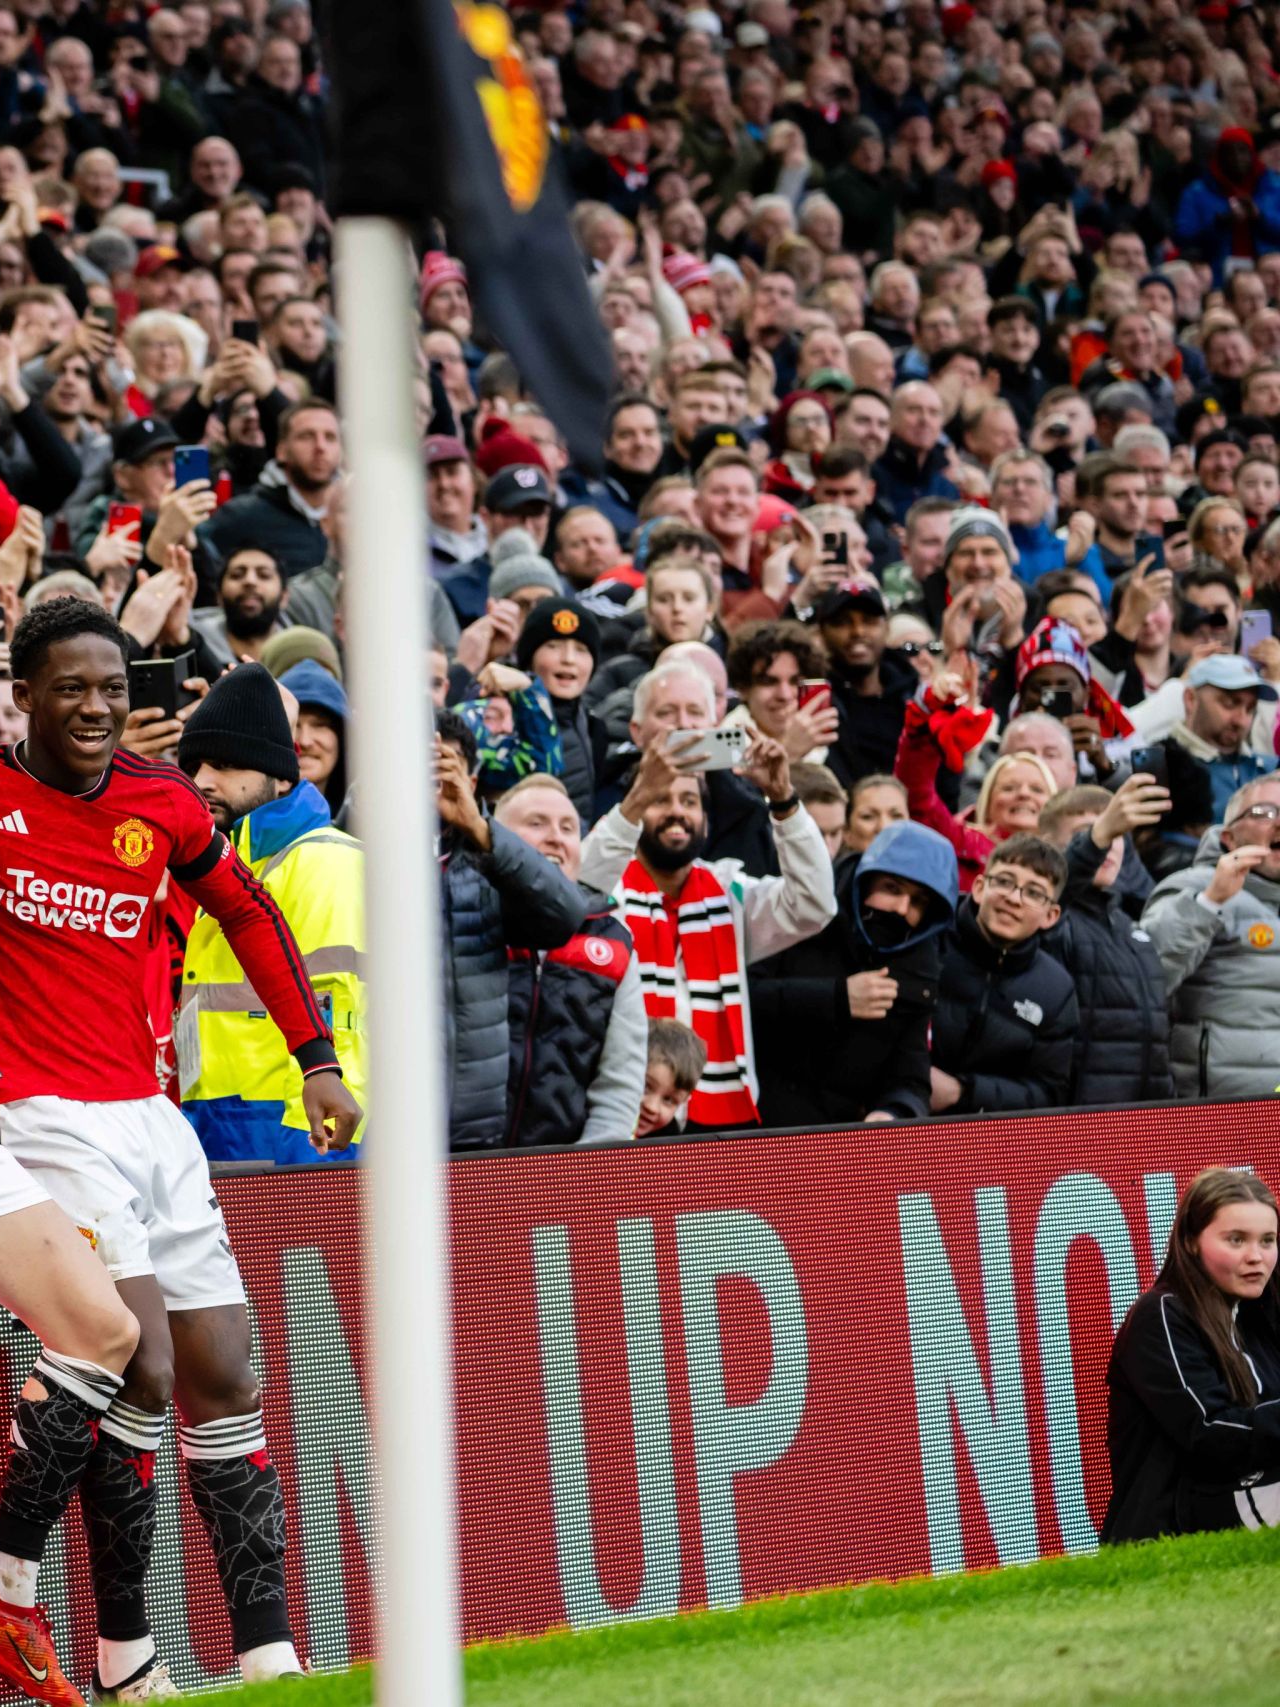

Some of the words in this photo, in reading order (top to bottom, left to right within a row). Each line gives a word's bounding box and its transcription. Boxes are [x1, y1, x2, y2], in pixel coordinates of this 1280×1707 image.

[121, 854, 145, 864] UNITED
[6, 867, 106, 911] Team
[531, 1208, 810, 1634] UP
